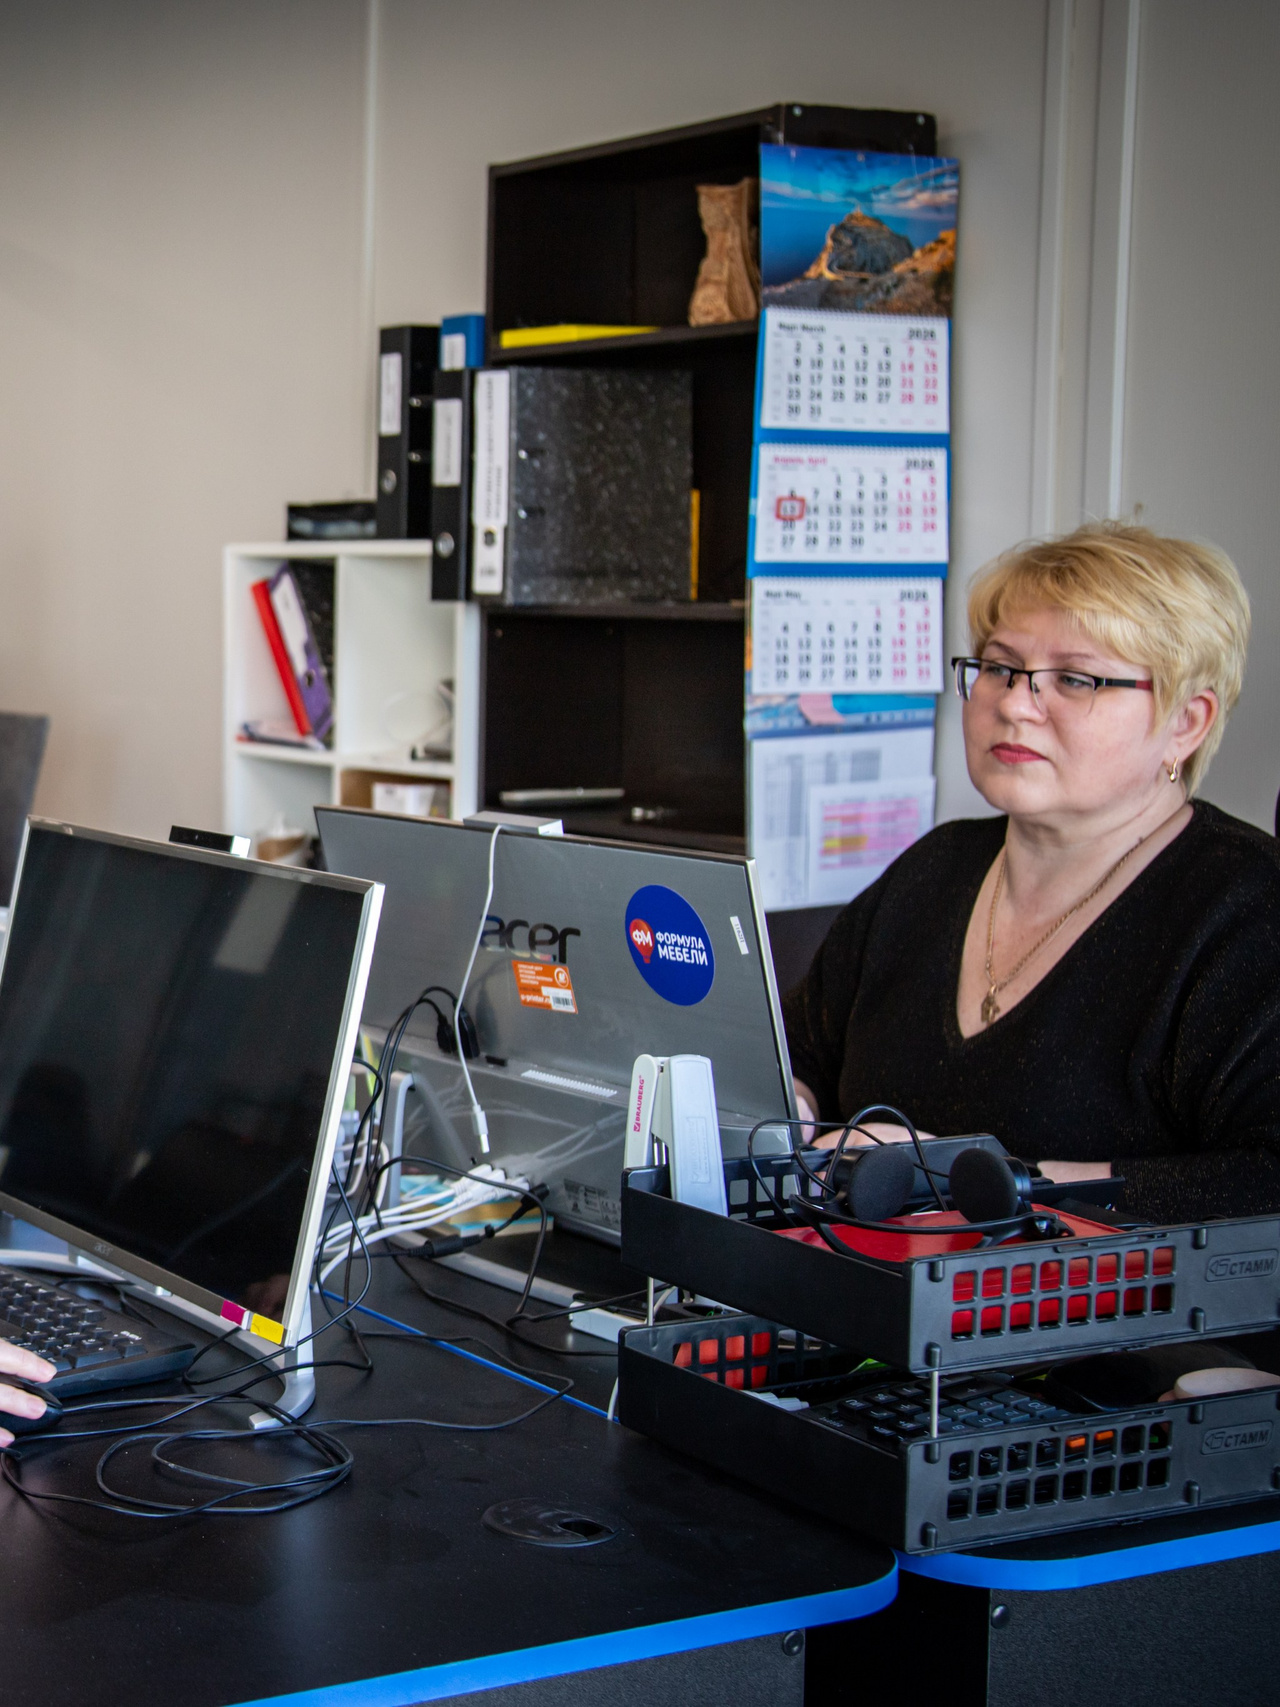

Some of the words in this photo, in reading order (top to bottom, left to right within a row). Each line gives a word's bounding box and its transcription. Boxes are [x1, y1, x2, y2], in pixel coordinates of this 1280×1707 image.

[908, 327, 936, 340] 2026
[906, 458, 935, 470] 2026
[480, 915, 581, 964] acer
[632, 929, 653, 947] ФМ
[656, 932, 705, 950] ФОРМУЛА
[658, 944, 708, 966] МЕБЕЛИ
[1229, 1258, 1275, 1275] СТАММ
[1223, 1430, 1269, 1447] СТАММ
